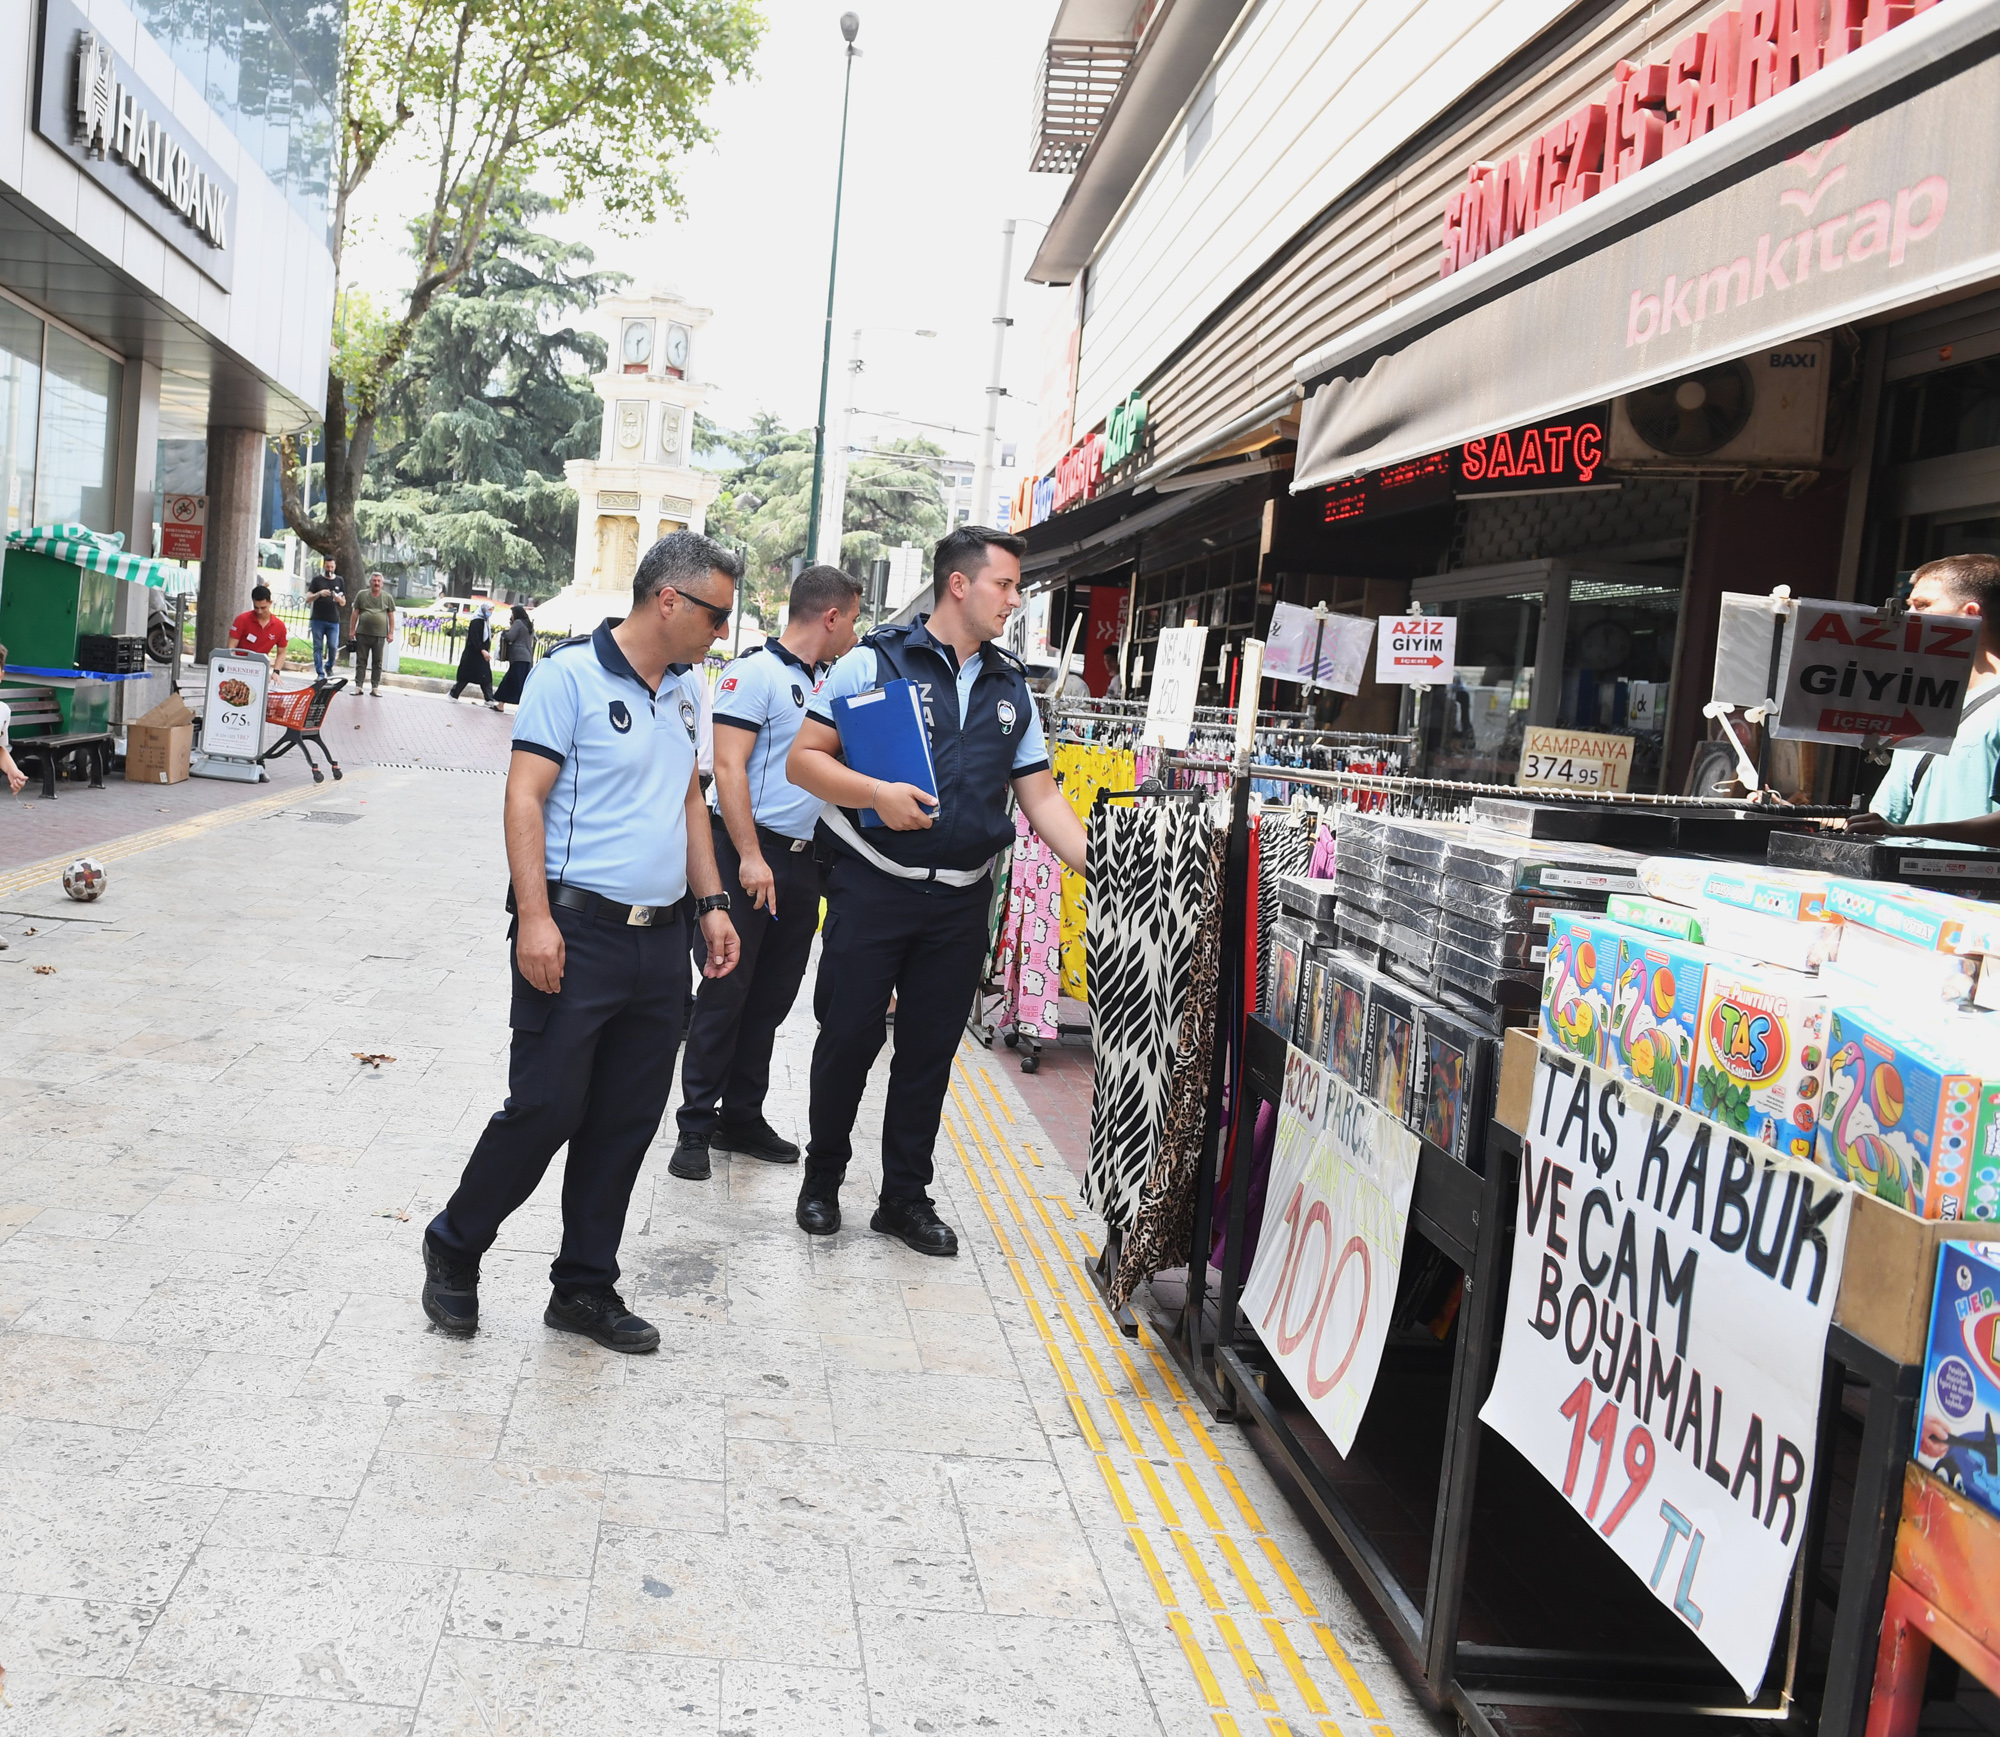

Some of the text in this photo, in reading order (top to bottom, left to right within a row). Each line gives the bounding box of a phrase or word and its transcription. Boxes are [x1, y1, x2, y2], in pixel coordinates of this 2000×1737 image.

[115, 82, 230, 250] HALKBANK
[1769, 353, 1816, 368] BAXI
[1461, 422, 1602, 481] SAATÇ
[1392, 620, 1443, 635] AZİZ
[1392, 637, 1442, 652] GİYİM
[1804, 612, 1973, 659] AZİZ
[1799, 660, 1960, 709] GİYİM
[1531, 733, 1628, 760] KAMPANYA
[1831, 711, 1893, 733] İÇERİ
[1602, 762, 1619, 788] TL
[1303, 960, 1311, 986] 1000
[1368, 1002, 1376, 1033] 1000
[1730, 982, 1788, 1018] PAINTING
[1721, 1002, 1771, 1077] TAŞ
[1276, 1112, 1307, 1168] ART
[1457, 1103, 1469, 1161] PUZZLE
[1525, 1138, 1574, 1260] VE
[1540, 1053, 1844, 1307] TAŞ KABUK
[1262, 1181, 1372, 1400] 100
[1528, 1252, 1805, 1547] BOYAMALAR
[1558, 1376, 1656, 1539] 119
[1650, 1498, 1706, 1631] TL
